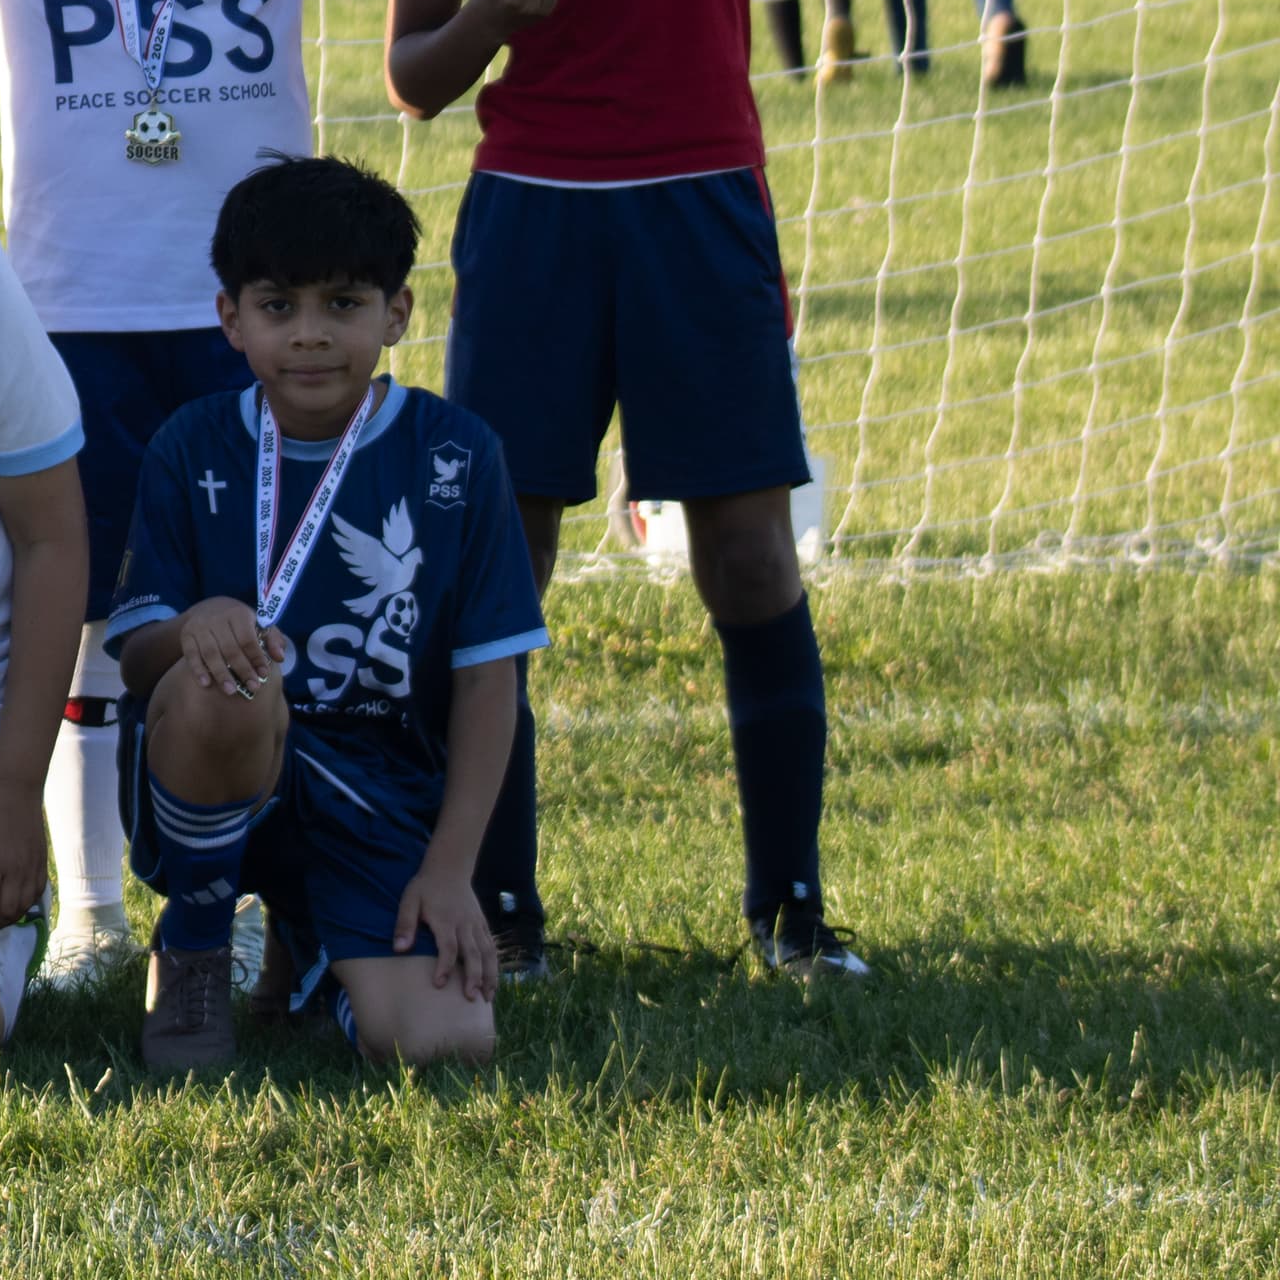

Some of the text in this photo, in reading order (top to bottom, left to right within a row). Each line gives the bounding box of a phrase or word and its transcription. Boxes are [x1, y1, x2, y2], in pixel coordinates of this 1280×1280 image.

[152, 27, 166, 60] 2026
[55, 81, 277, 111] PEACE SOCCER SCHOOL
[126, 145, 179, 160] SOCCER
[263, 430, 274, 453] 2026
[262, 465, 272, 487] 2026
[429, 483, 460, 499] PSS
[265, 593, 282, 619] 2026
[280, 558, 298, 583] 2026
[298, 521, 315, 548] 2026
[315, 487, 331, 512] 2026
[333, 450, 348, 477] 2026
